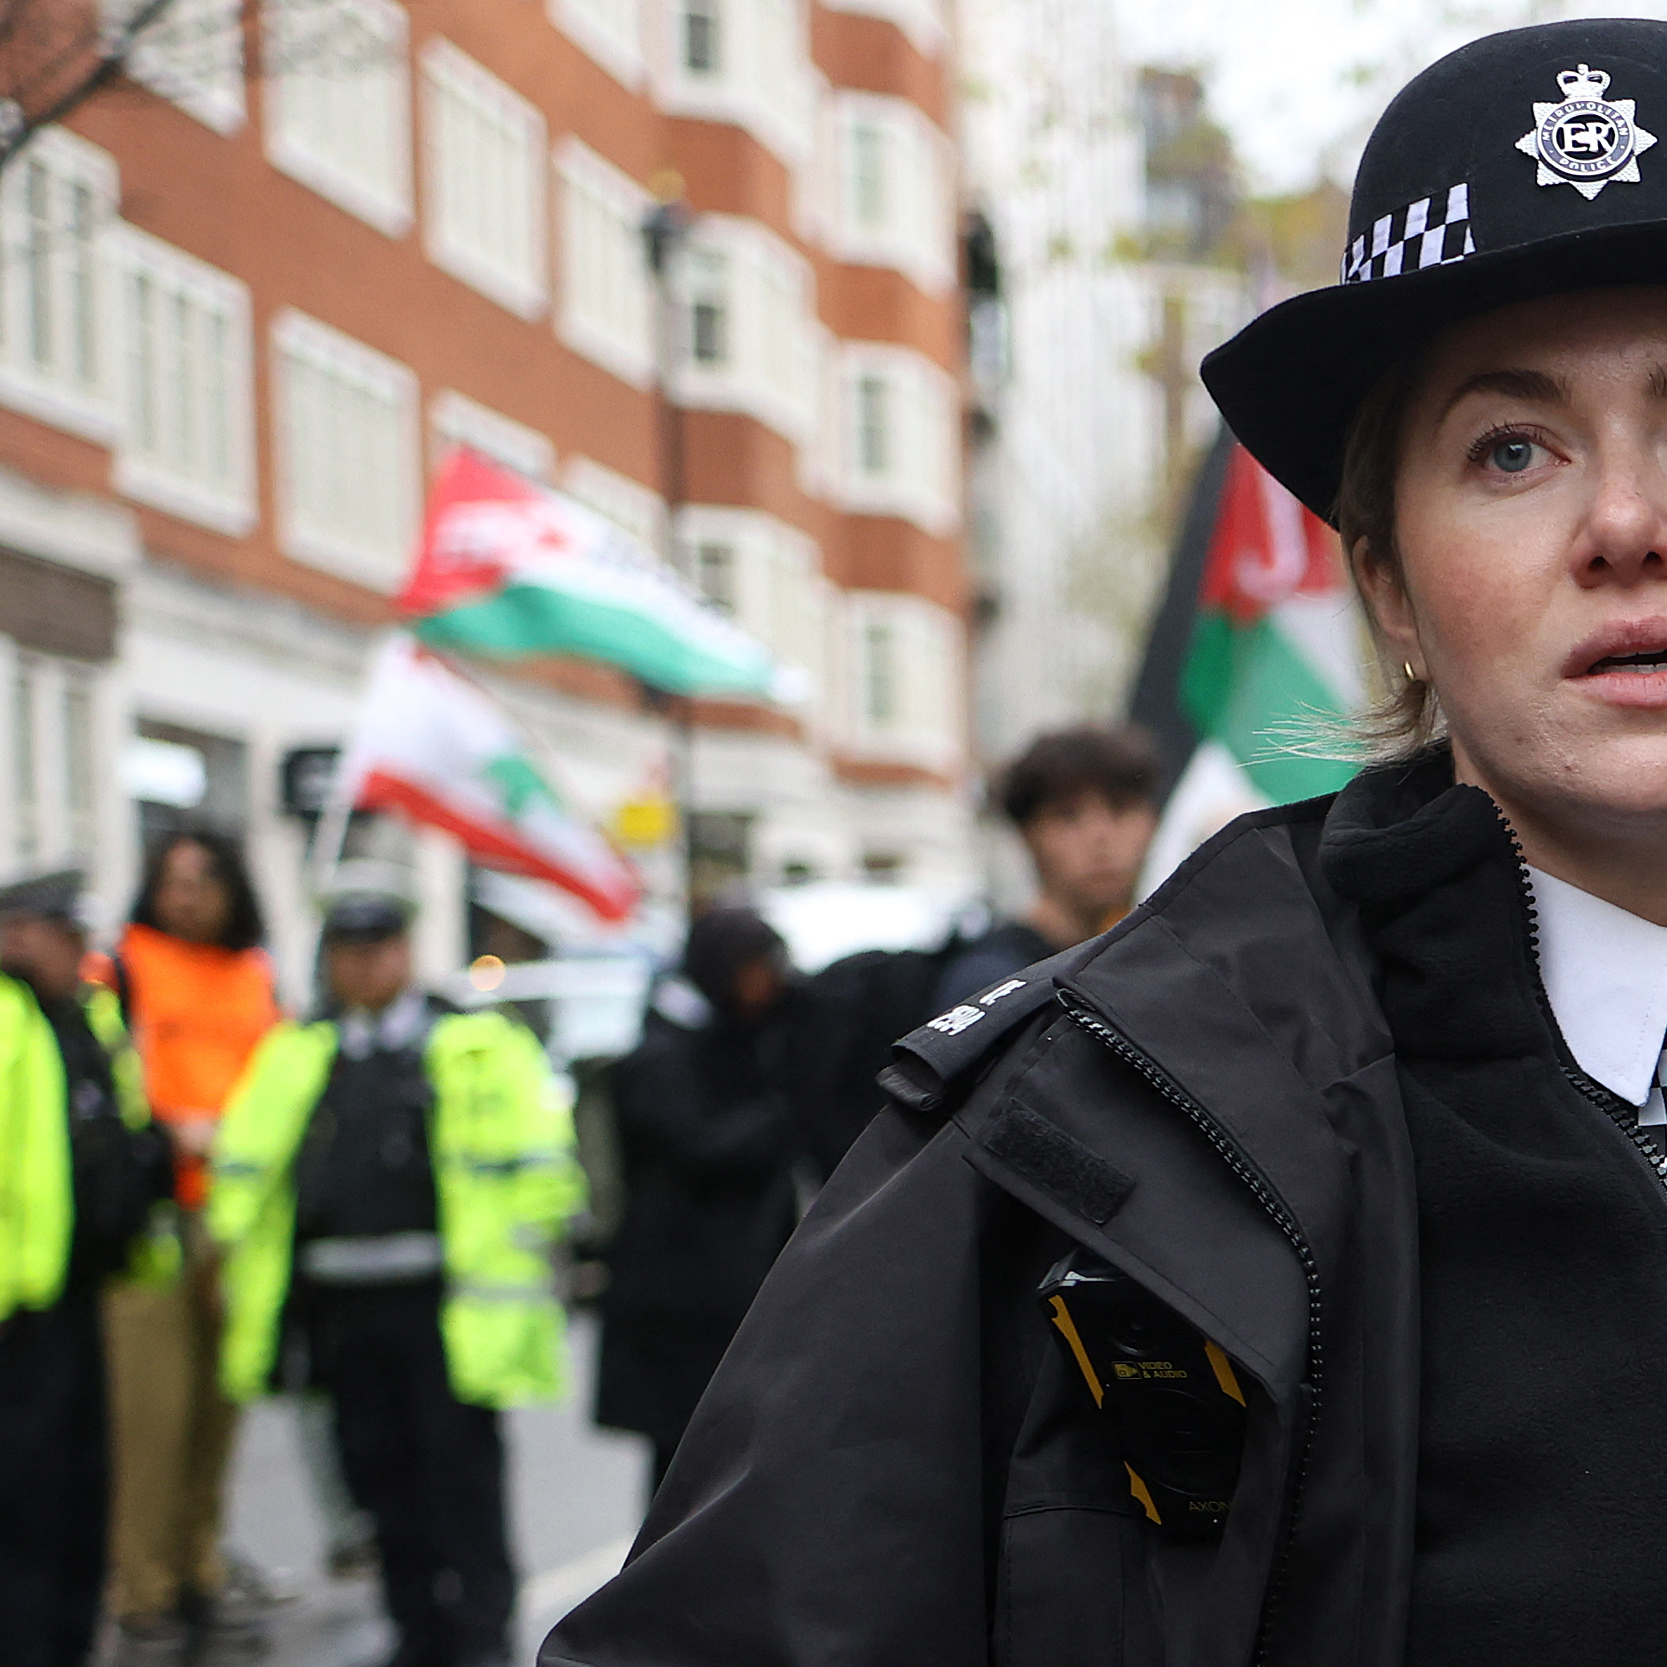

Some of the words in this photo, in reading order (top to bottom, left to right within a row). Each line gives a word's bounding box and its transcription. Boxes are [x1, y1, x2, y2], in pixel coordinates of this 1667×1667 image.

[1541, 101, 1629, 141] METROPOLITAN
[1558, 156, 1618, 173] POLICE
[1137, 1361, 1173, 1370] VIDEO
[1153, 1370, 1188, 1379] AUDIO
